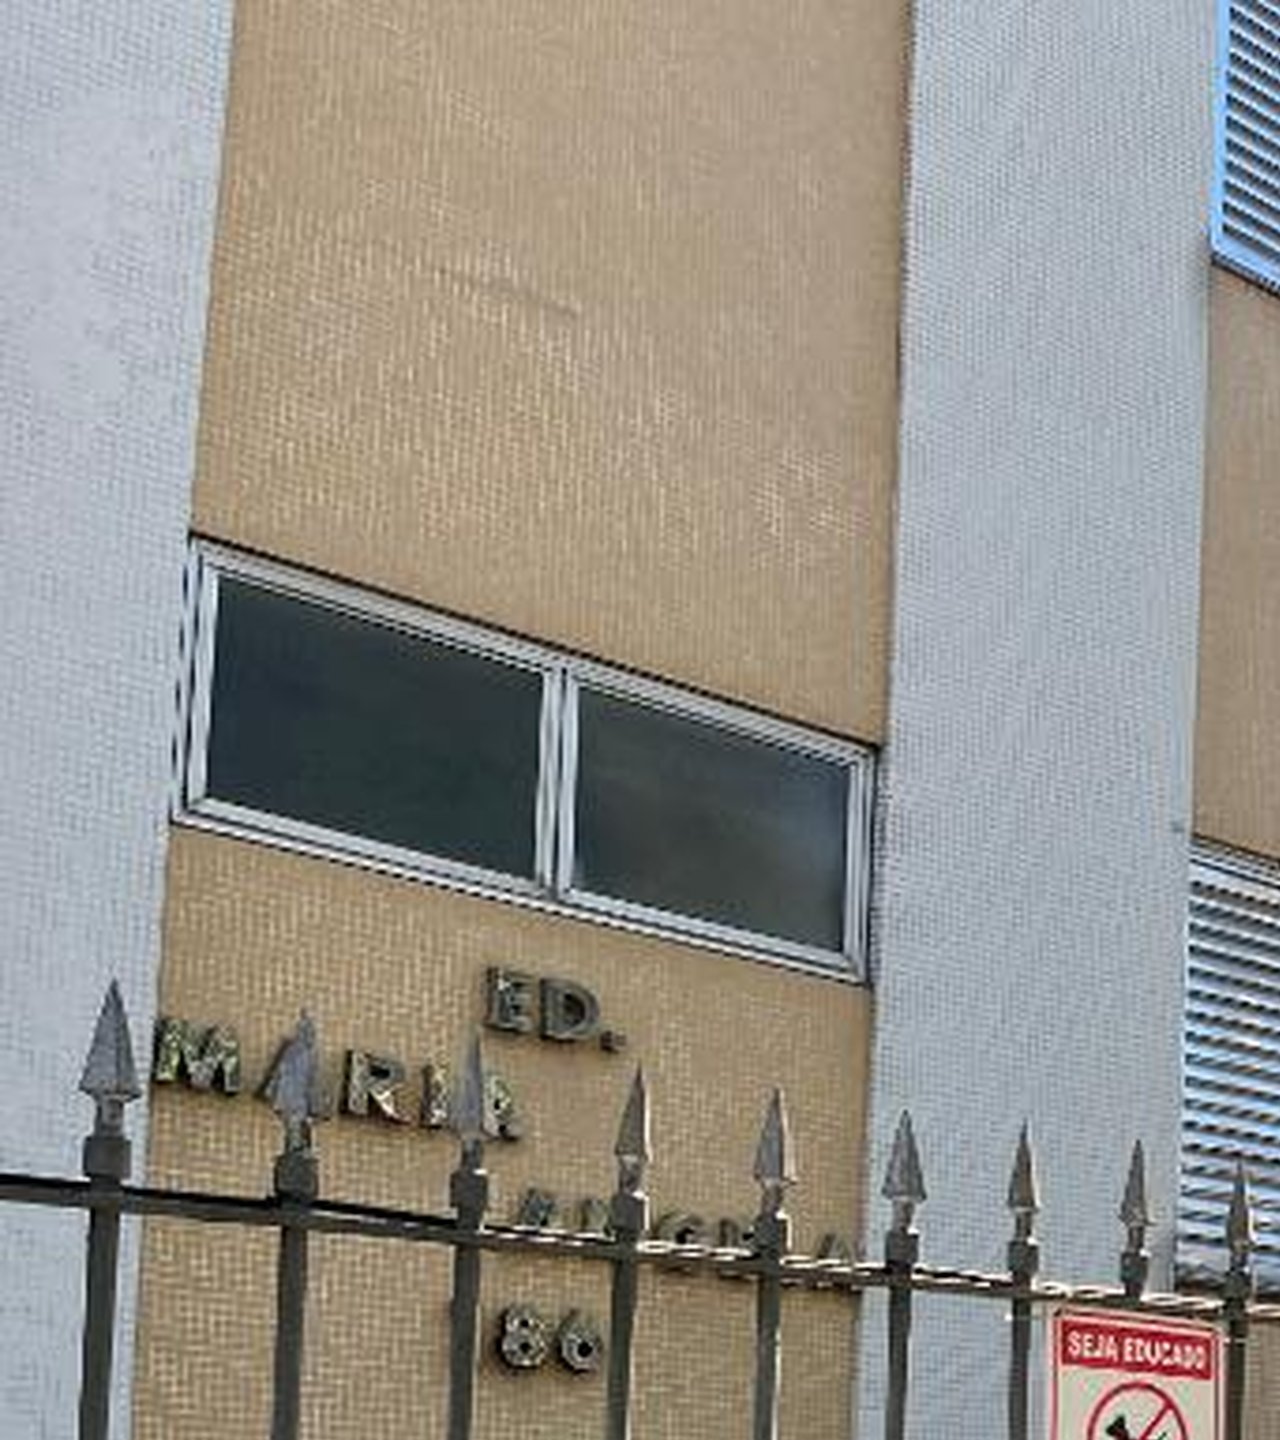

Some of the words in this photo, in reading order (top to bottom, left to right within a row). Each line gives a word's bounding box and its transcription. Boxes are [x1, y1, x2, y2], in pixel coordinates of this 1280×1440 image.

[484, 966, 626, 1052] ED.
[152, 1017, 522, 1141] MRIA
[500, 1303, 602, 1374] 86
[1067, 1329, 1118, 1363] SEJA
[1124, 1337, 1206, 1370] EDUCADO
